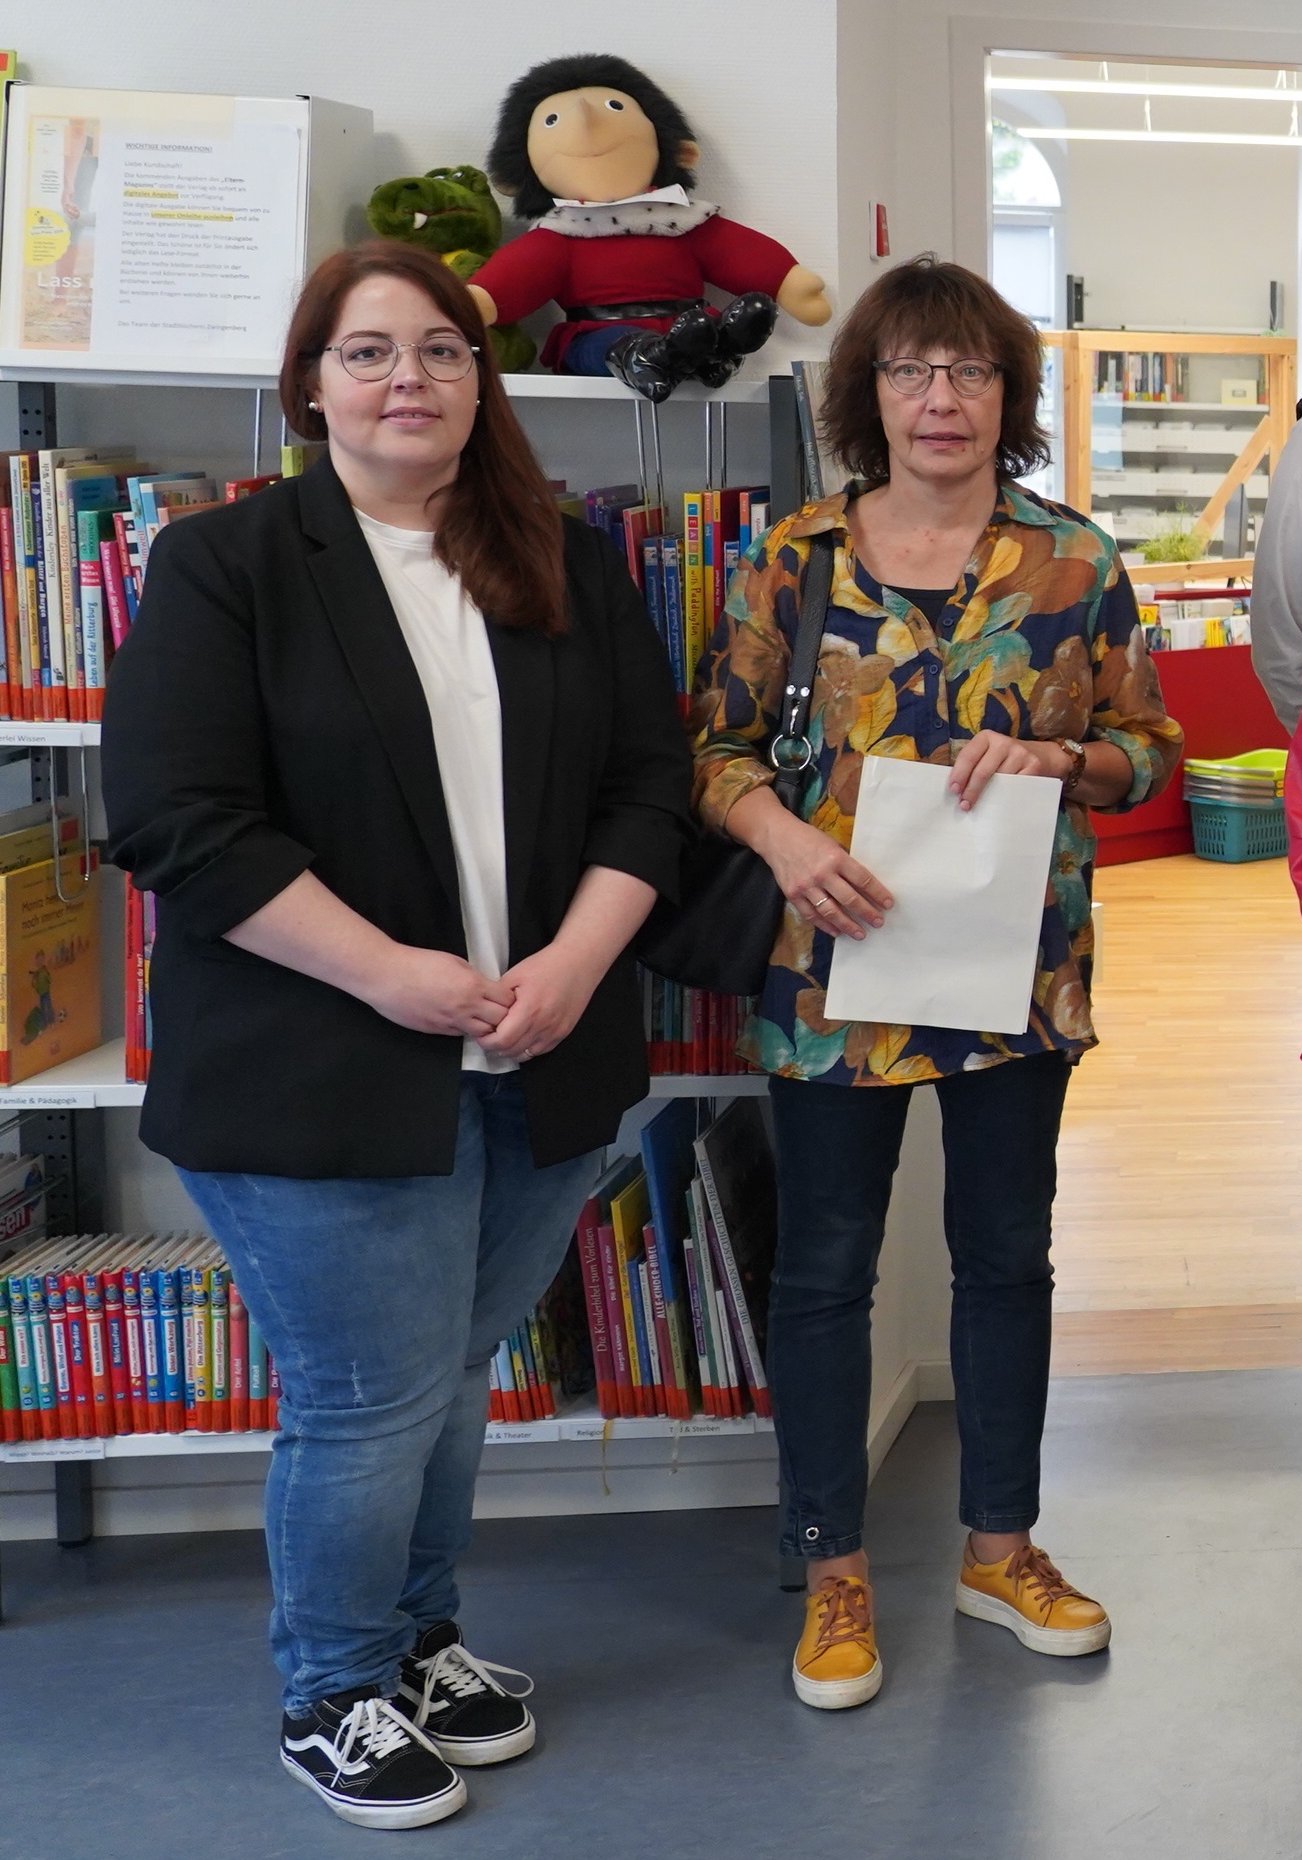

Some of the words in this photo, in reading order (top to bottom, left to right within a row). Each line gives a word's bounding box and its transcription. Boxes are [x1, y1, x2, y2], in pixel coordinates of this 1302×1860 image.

[37, 272, 82, 288] Lass
[41, 462, 51, 480] Welt
[42, 482, 52, 497] aller
[43, 511, 55, 538] Kinder
[46, 541, 57, 579] Kindersley
[59, 524, 71, 573] Buchstaben
[62, 574, 71, 601] ersten
[63, 601, 73, 625] Meine
[86, 602, 98, 640] Ritterburg
[87, 640, 97, 653] der
[88, 652, 98, 667] auf
[87, 666, 98, 688] Leben
[584, 1227, 598, 1264] Vorlesen
[590, 1265, 600, 1284] zum
[648, 1244, 666, 1320] ALLE-KINDER-BIBEL
[728, 1268, 746, 1307] GROSSEN
[591, 1284, 606, 1335] Kinderbibel
[739, 1308, 750, 1325] DIE
[73, 1324, 81, 1349] Traktor
[111, 1322, 120, 1347] Laufrad
[168, 1321, 177, 1354] Werkzeug
[597, 1336, 608, 1353] Die
[169, 1353, 177, 1374] Unser
[233, 1358, 244, 1377] Apfel
[234, 1376, 242, 1389] Der
[252, 1364, 261, 1389] Fußball
[504, 1431, 532, 1439] Theater
